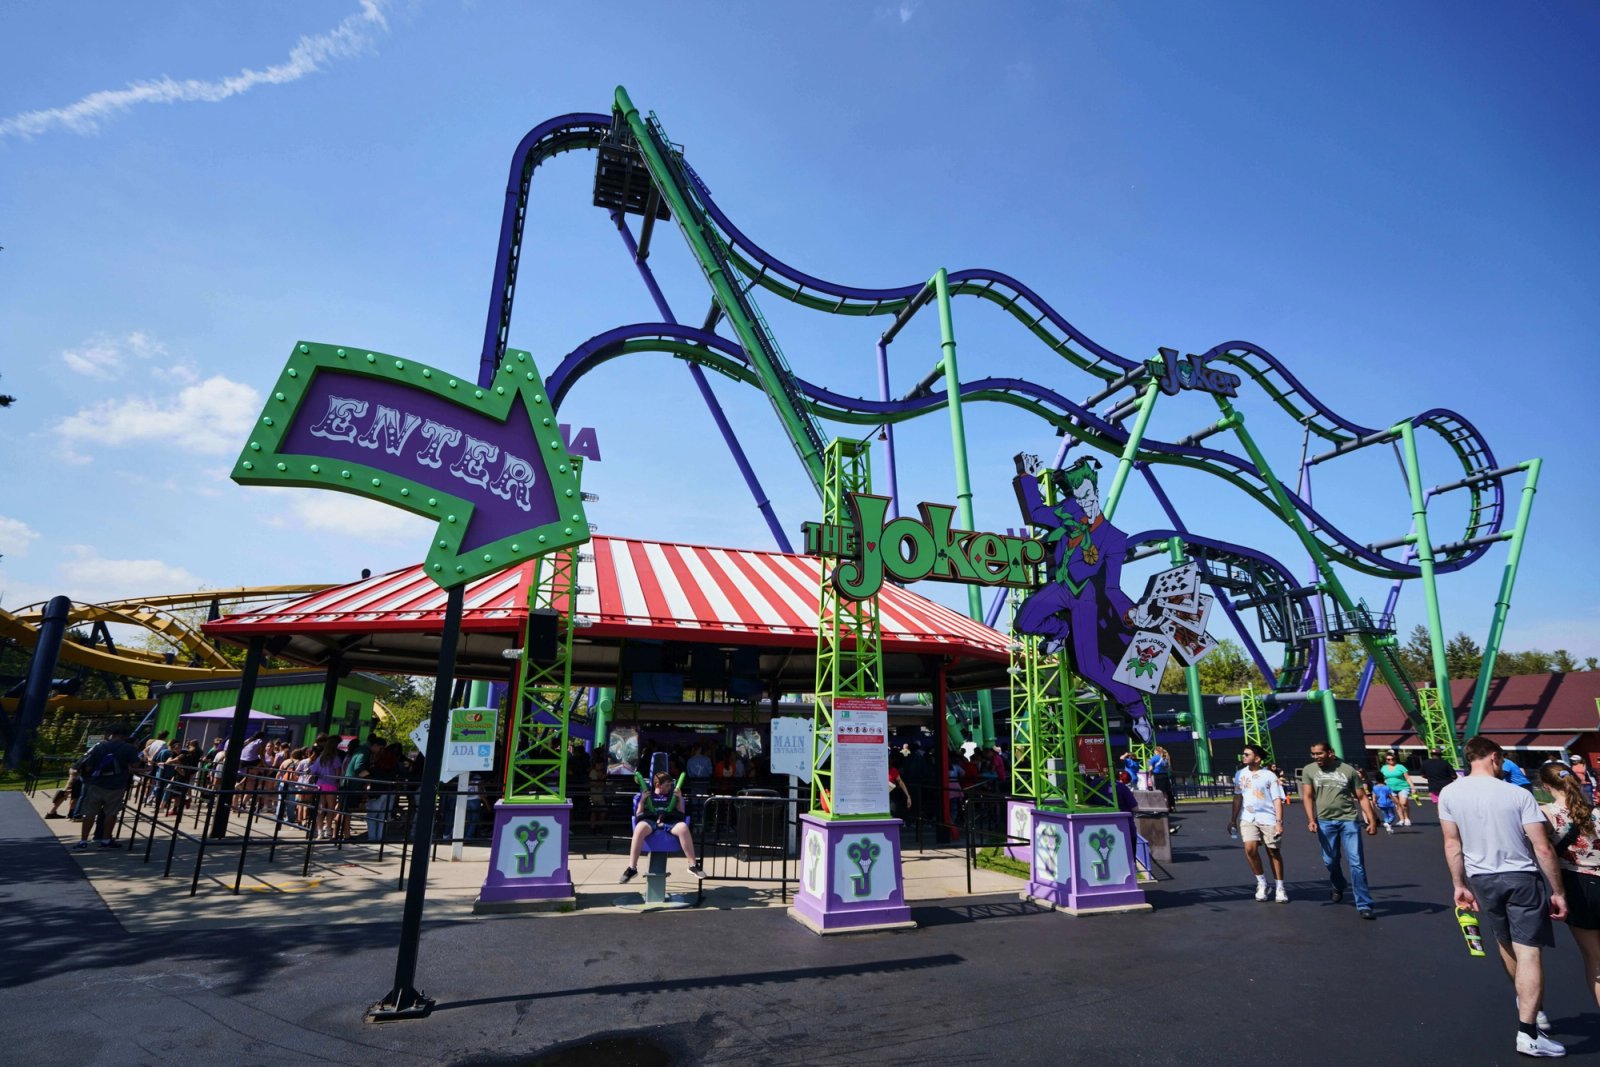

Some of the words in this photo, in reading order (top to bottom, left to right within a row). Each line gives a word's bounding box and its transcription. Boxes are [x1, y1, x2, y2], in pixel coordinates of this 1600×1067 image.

[1158, 346, 1241, 398] Joker
[310, 395, 537, 512] ENTER
[801, 521, 858, 559] THE
[832, 492, 1046, 600] Joker
[1149, 638, 1167, 648] JOKER
[452, 744, 474, 756] ADA
[774, 736, 805, 748] MAIN
